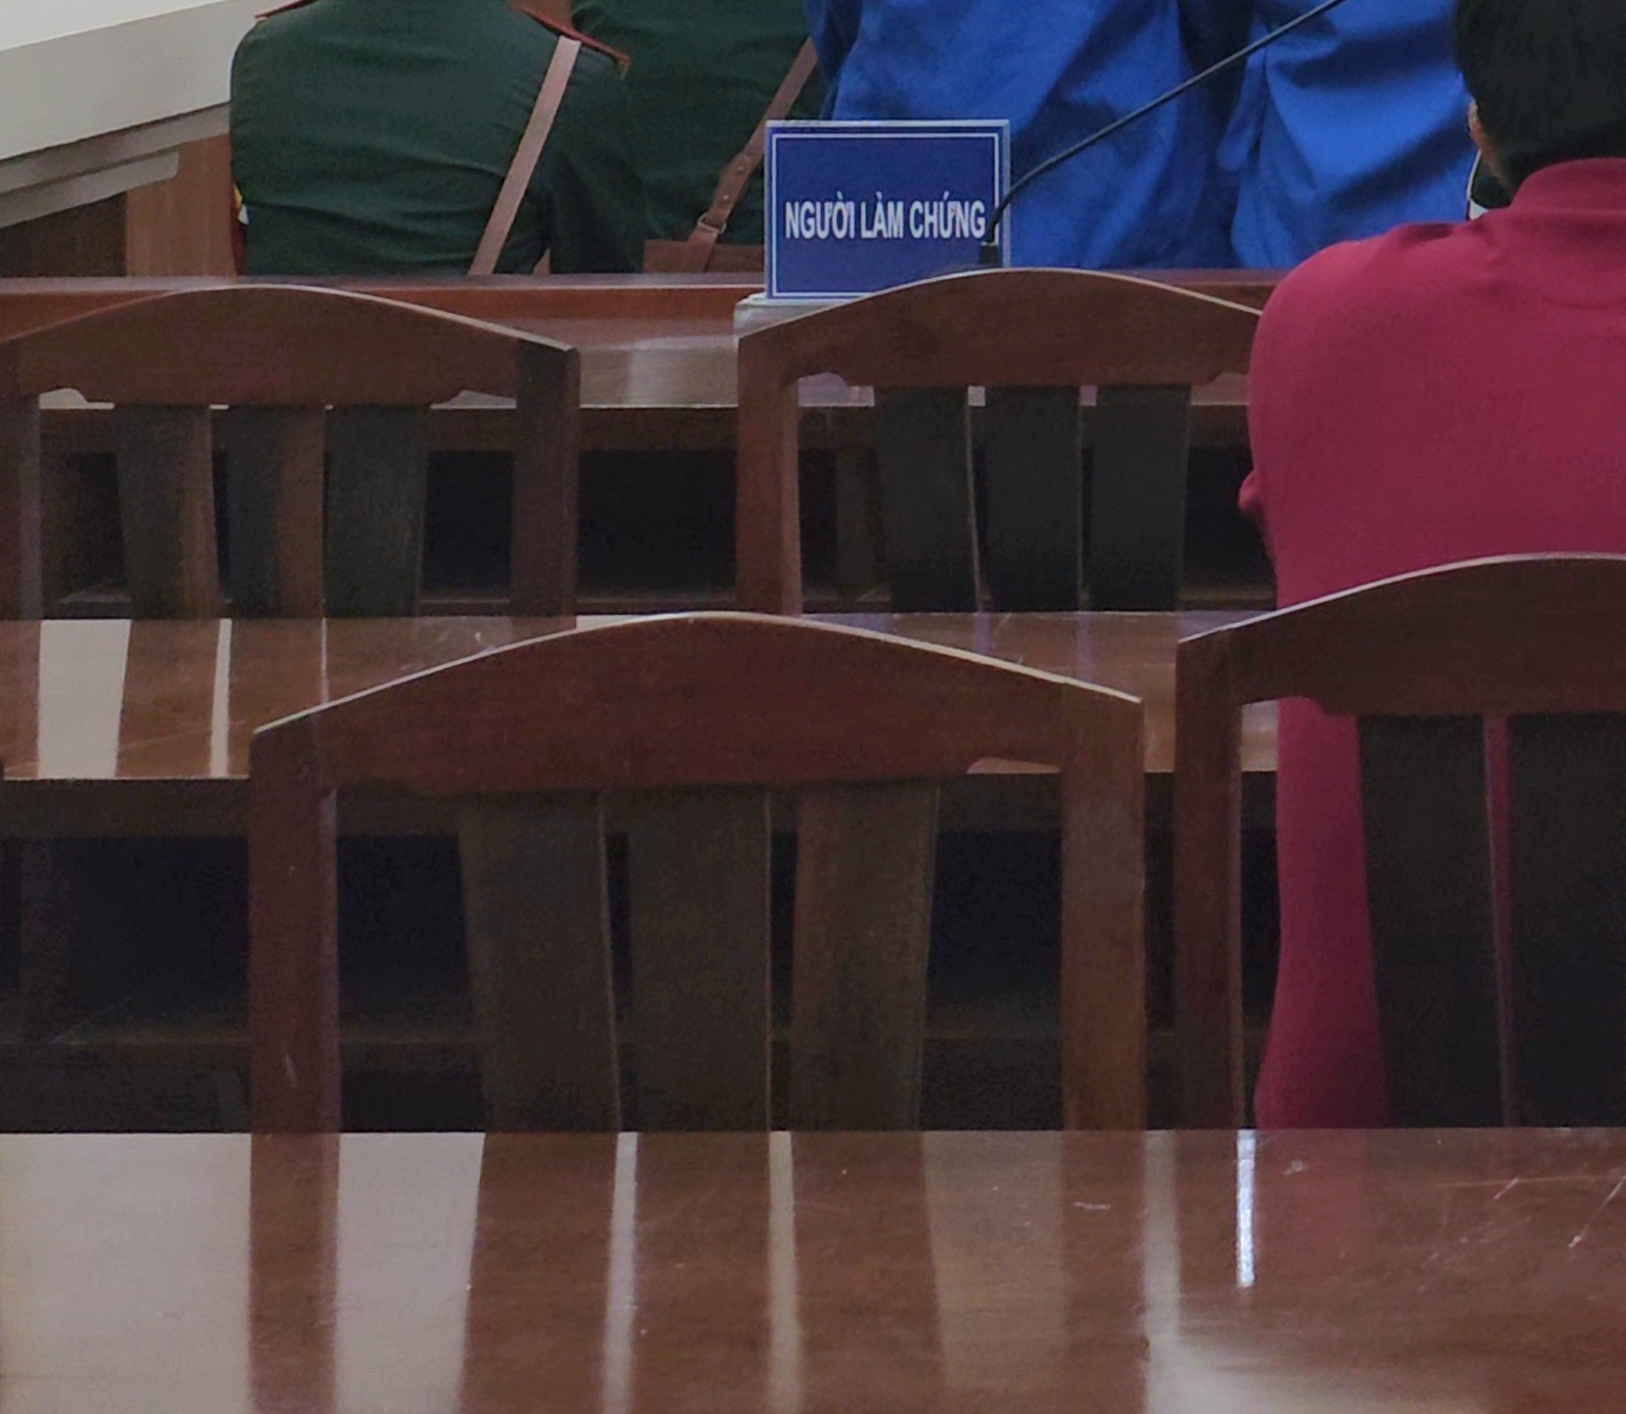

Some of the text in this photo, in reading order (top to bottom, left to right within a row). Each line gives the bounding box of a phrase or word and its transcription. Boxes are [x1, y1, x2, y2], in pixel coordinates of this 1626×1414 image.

[785, 190, 986, 239] NGƯỜI LÀM CHỨNG
